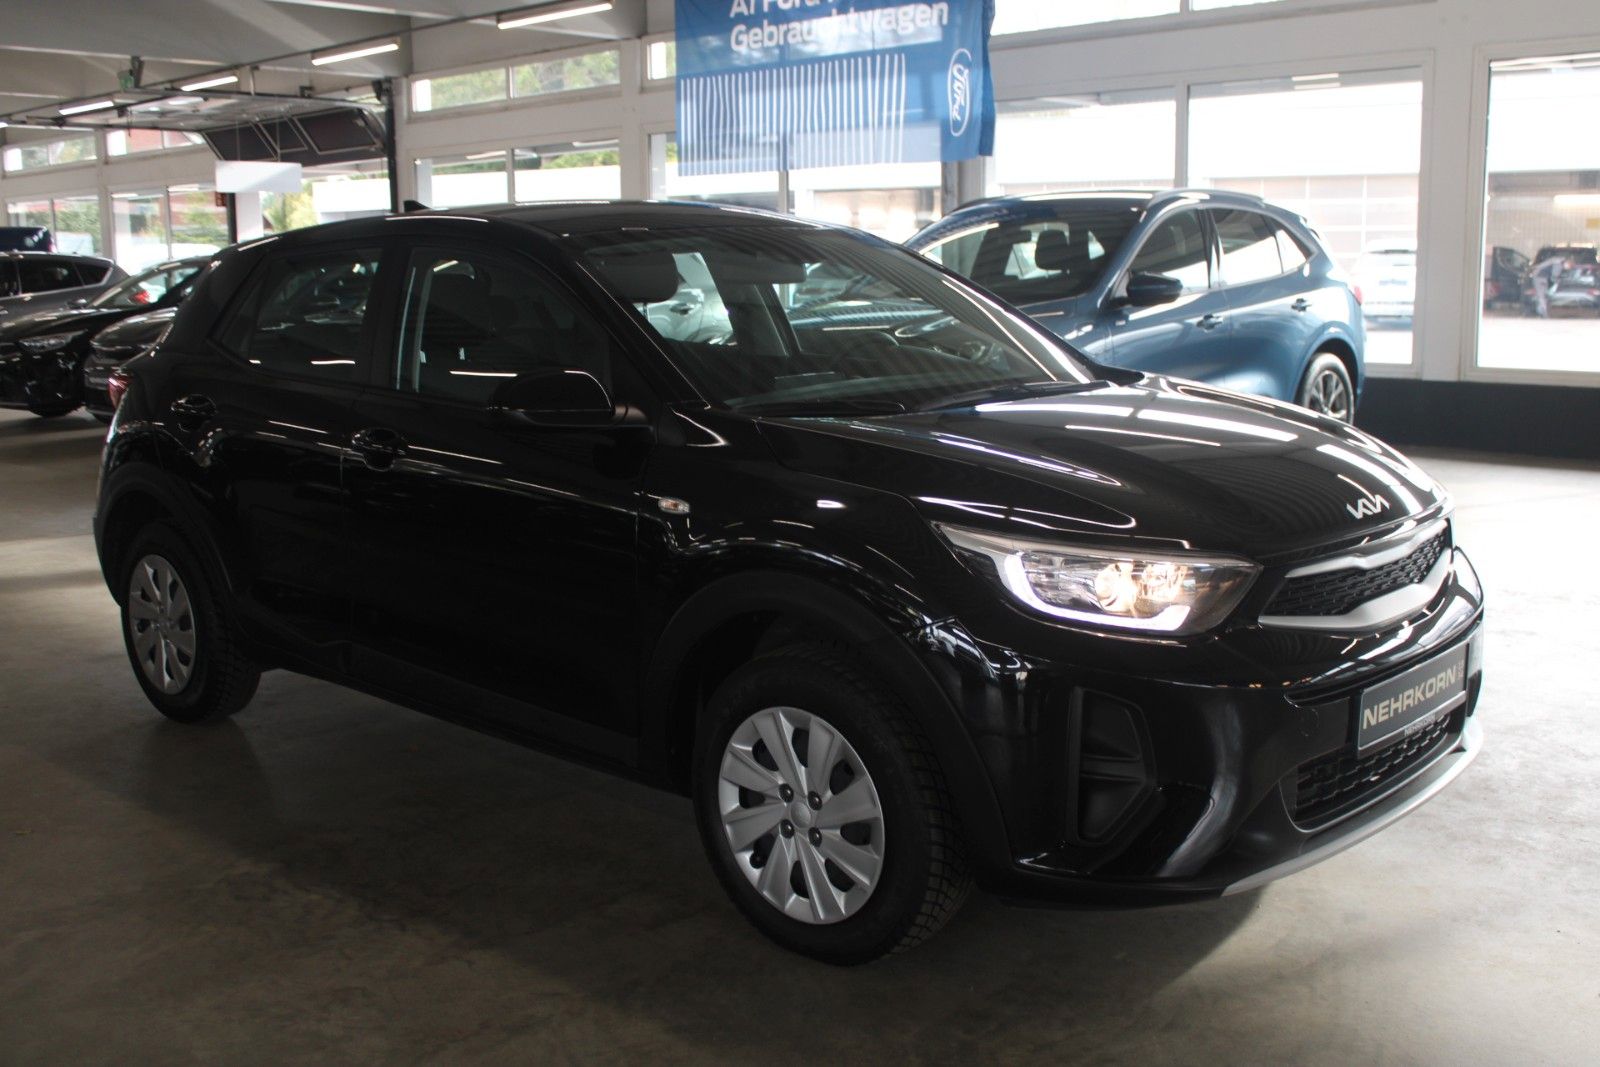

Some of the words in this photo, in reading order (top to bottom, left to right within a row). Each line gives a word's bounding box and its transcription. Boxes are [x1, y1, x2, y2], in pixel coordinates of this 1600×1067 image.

[730, 2, 949, 53] Gebrautwagen
[952, 63, 969, 121] Ford
[1362, 665, 1457, 730] NEHRKORN
